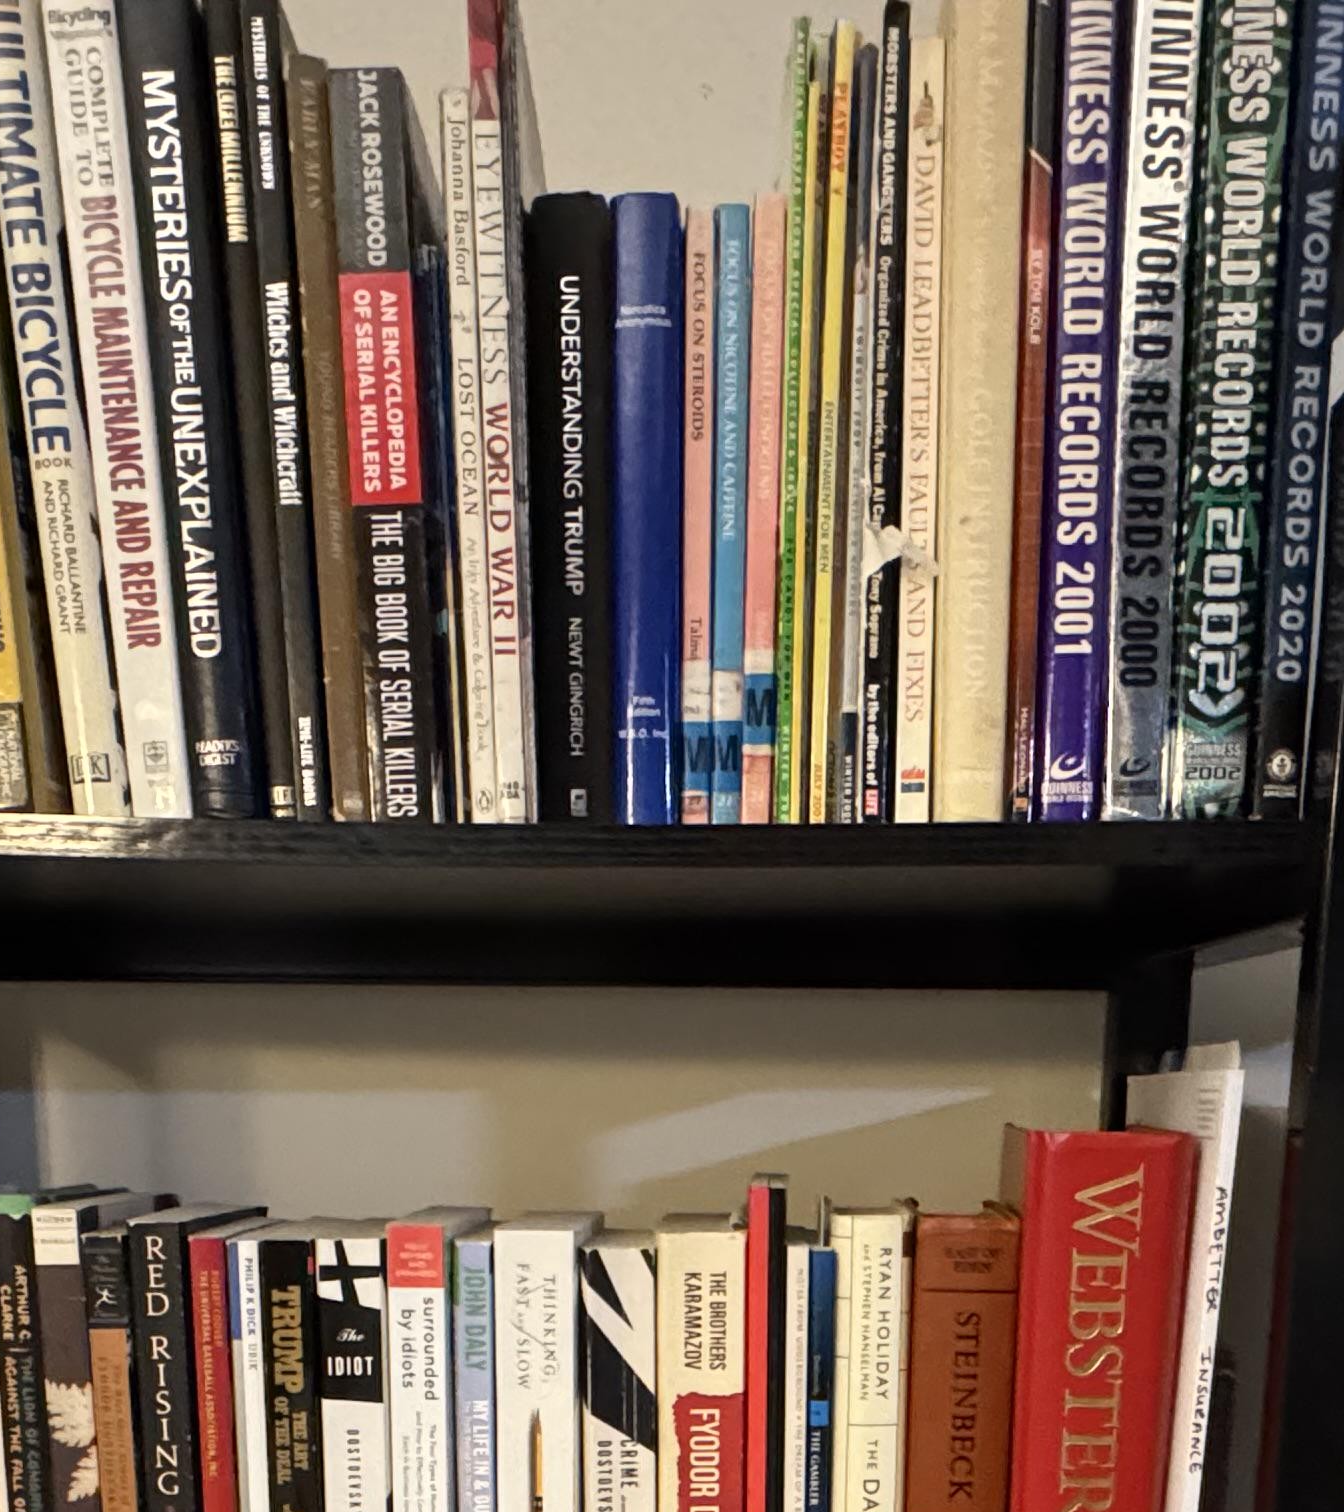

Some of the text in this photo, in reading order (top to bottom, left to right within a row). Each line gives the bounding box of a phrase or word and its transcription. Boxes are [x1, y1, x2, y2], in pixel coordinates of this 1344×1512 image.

[357, 69, 387, 266] JACK ROSEWOOD
[12, 262, 72, 454] BICYCLE
[142, 70, 222, 659] MYSTERIES OF THE UNEXPLAINED
[354, 289, 381, 493] OF SERIAL KILLERS
[379, 290, 407, 490] AN ENCYCLOPEDIA
[446, 116, 478, 516] Johanna Basford LOST OCEAN
[474, 131, 517, 656] EYEWITNESS WORLD WAR II
[1198, 136, 1267, 693] WORLD RECORDS 2002
[35, 457, 73, 470] BOOK
[80, 195, 162, 650] BICYCLE MAINTENANCE AND REPAIR
[559, 276, 584, 756] UNDERSTANDING TRUMP NEWT GINGRICH
[1054, 182, 1107, 654] WORLD RECORDS 2001
[1119, 203, 1180, 688] WORLD RECORDS 2000
[1277, 190, 1335, 682] WORLD RECORDS 2020
[370, 511, 419, 819] THE BIG BOOK OF SERIAL KILLERS
[144, 1236, 180, 1496] RED RISING
[271, 1285, 305, 1394] TRUMP
[327, 1356, 373, 1376] IDIOT
[401, 1309, 413, 1388] by idiots
[422, 1298, 439, 1400] surrounded
[684, 1272, 702, 1369] KARAMAZOV
[710, 1272, 727, 1371] THE BROTHERS
[875, 1247, 893, 1401] RYAN HOLIDAY
[948, 1313, 980, 1499] STEINBECK
[1190, 1187, 1227, 1474] AMBETTER INSURANCE
[620, 1440, 639, 1489] CRIME
[689, 1408, 720, 1499] FYODOR
[866, 1440, 878, 1471] THE
